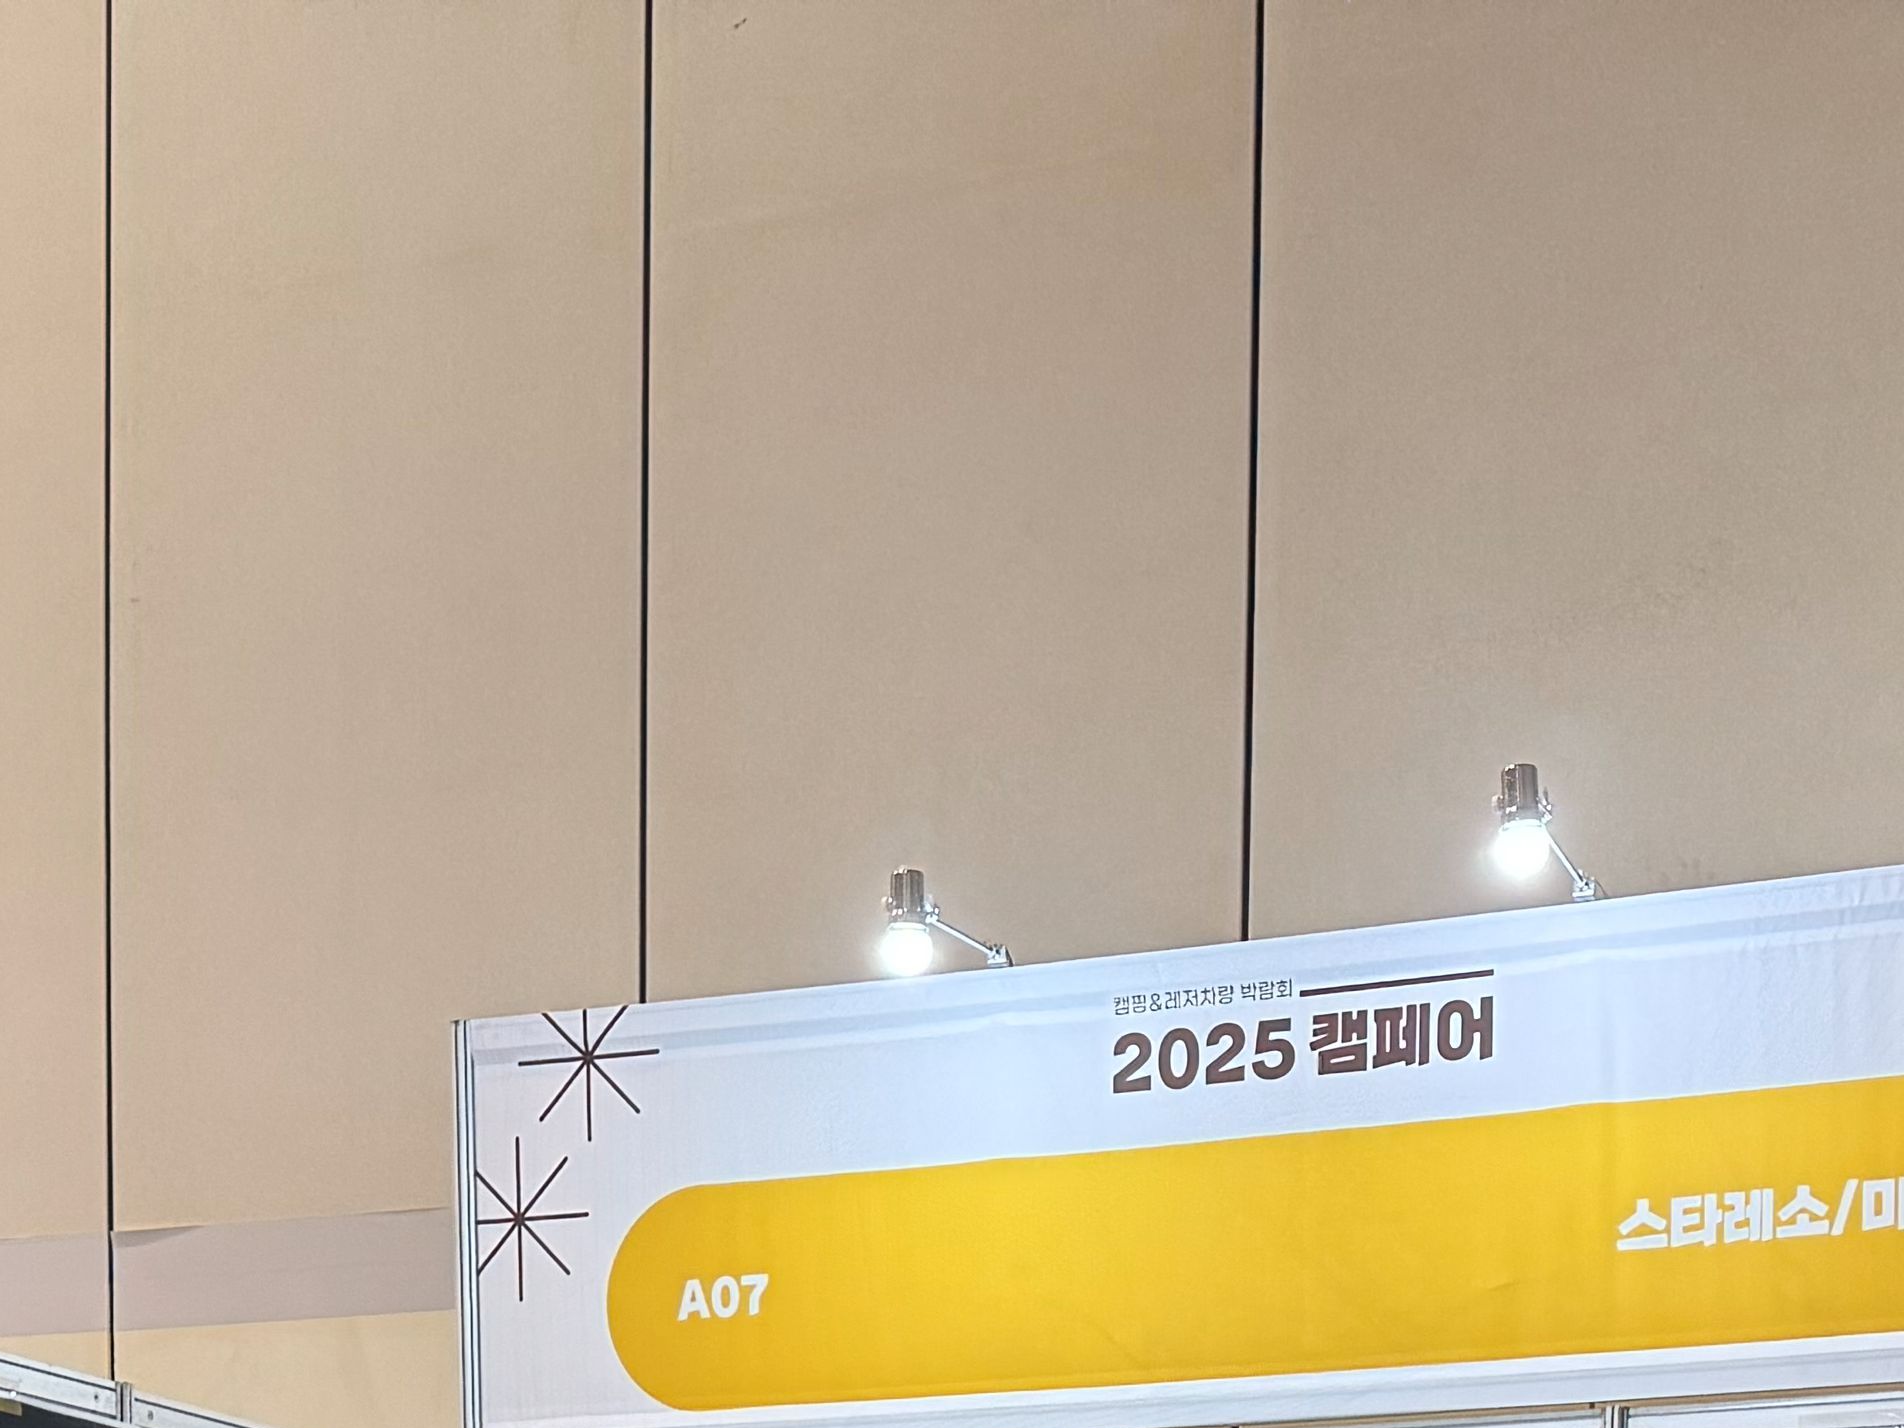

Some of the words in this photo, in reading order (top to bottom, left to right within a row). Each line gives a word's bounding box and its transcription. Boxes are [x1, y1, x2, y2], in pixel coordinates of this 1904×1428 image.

[1113, 984, 1234, 1016] 캠핑&레저차량
[1240, 978, 1294, 1001] 박람회
[1112, 1017, 1296, 1094] 2025
[1309, 995, 1495, 1076] 캠페어
[677, 1273, 769, 1322] A07
